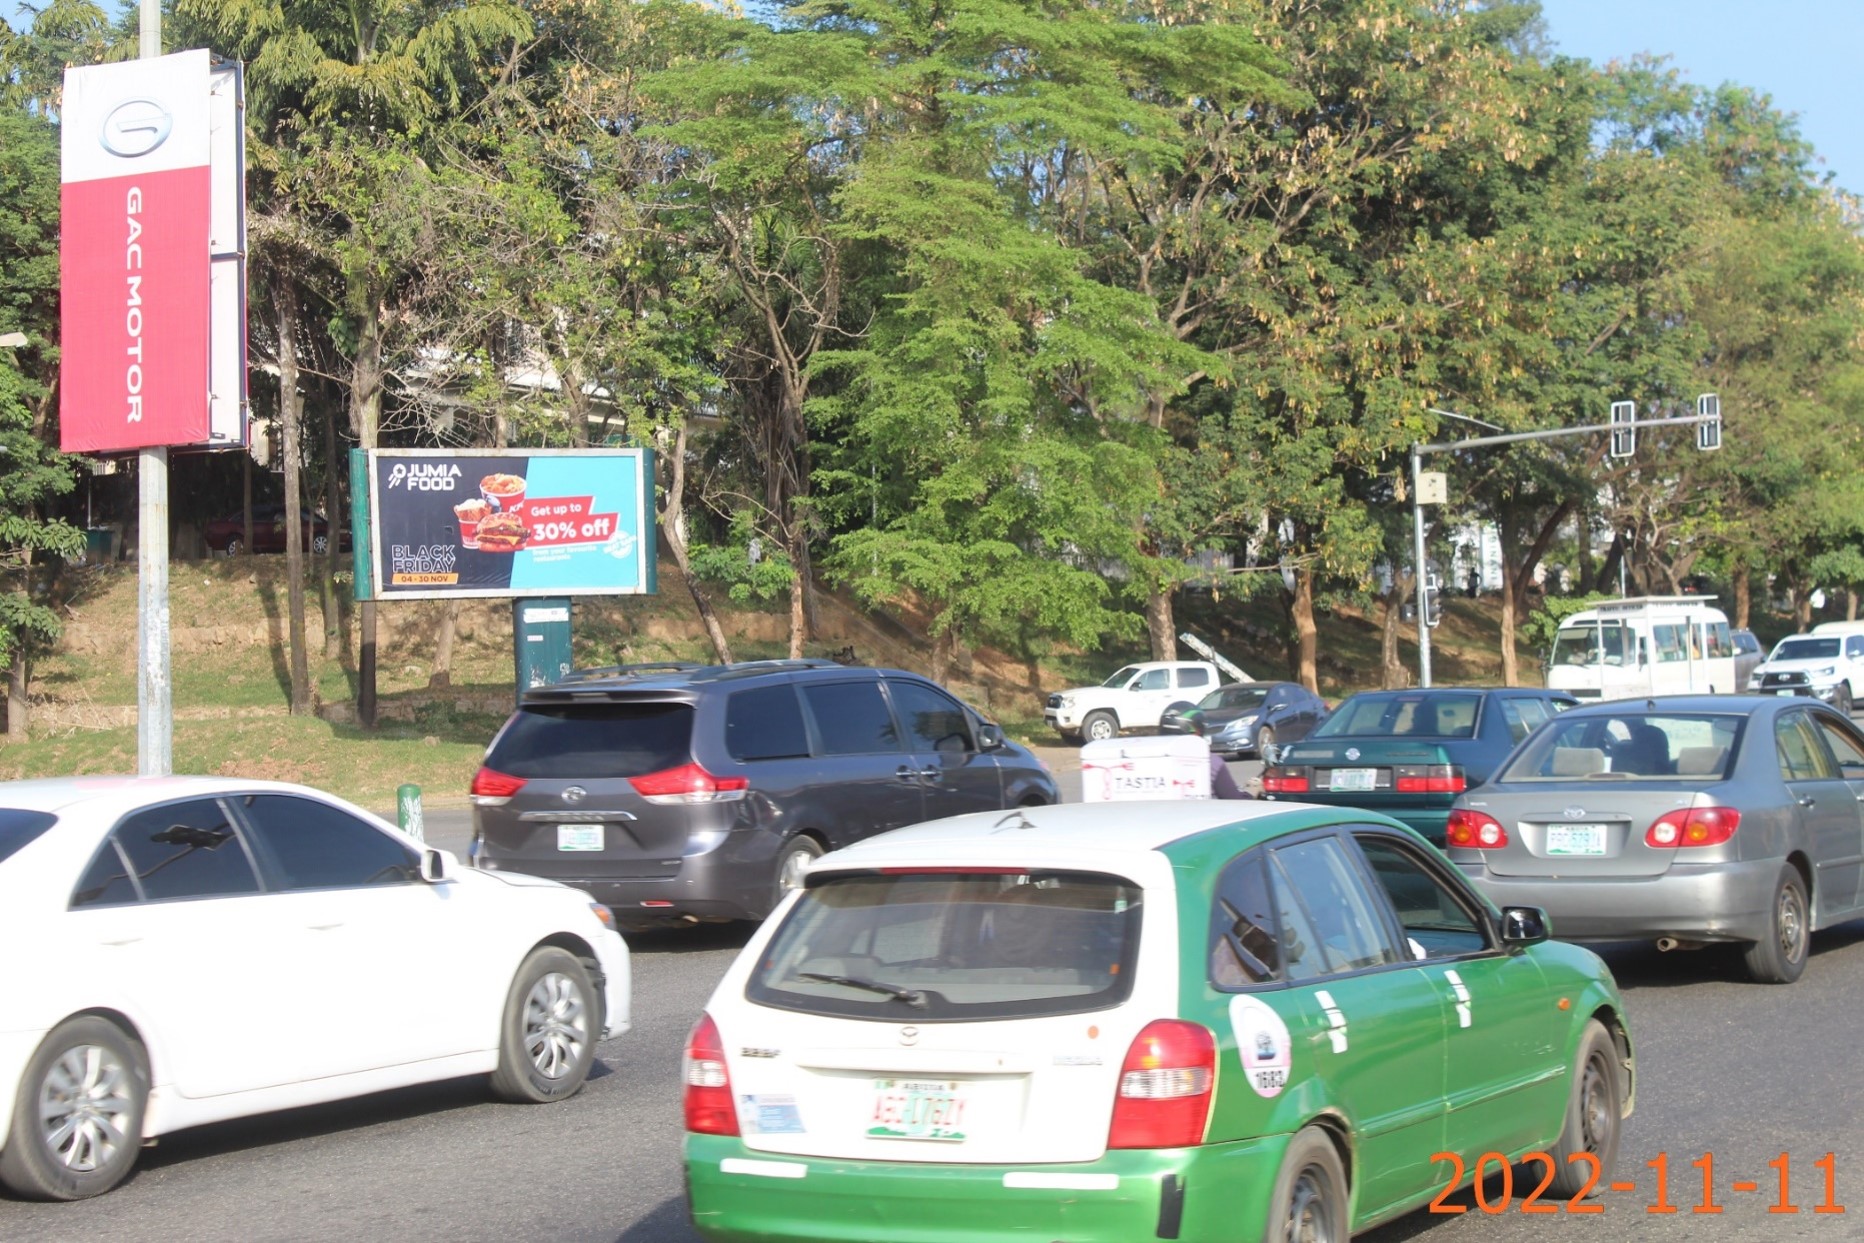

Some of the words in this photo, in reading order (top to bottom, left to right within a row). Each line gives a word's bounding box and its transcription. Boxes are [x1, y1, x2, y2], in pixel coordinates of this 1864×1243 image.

[126, 186, 143, 270] GAC
[126, 275, 143, 424] MOTOR
[407, 463, 462, 477] JUMIA
[407, 477, 455, 491] FOOD
[531, 506, 551, 517] Get
[553, 505, 567, 515] up
[570, 503, 582, 513] to
[533, 521, 577, 541] 30%
[581, 518, 610, 537] off
[391, 544, 456, 560] BLACK
[392, 558, 456, 573] FRIDAY
